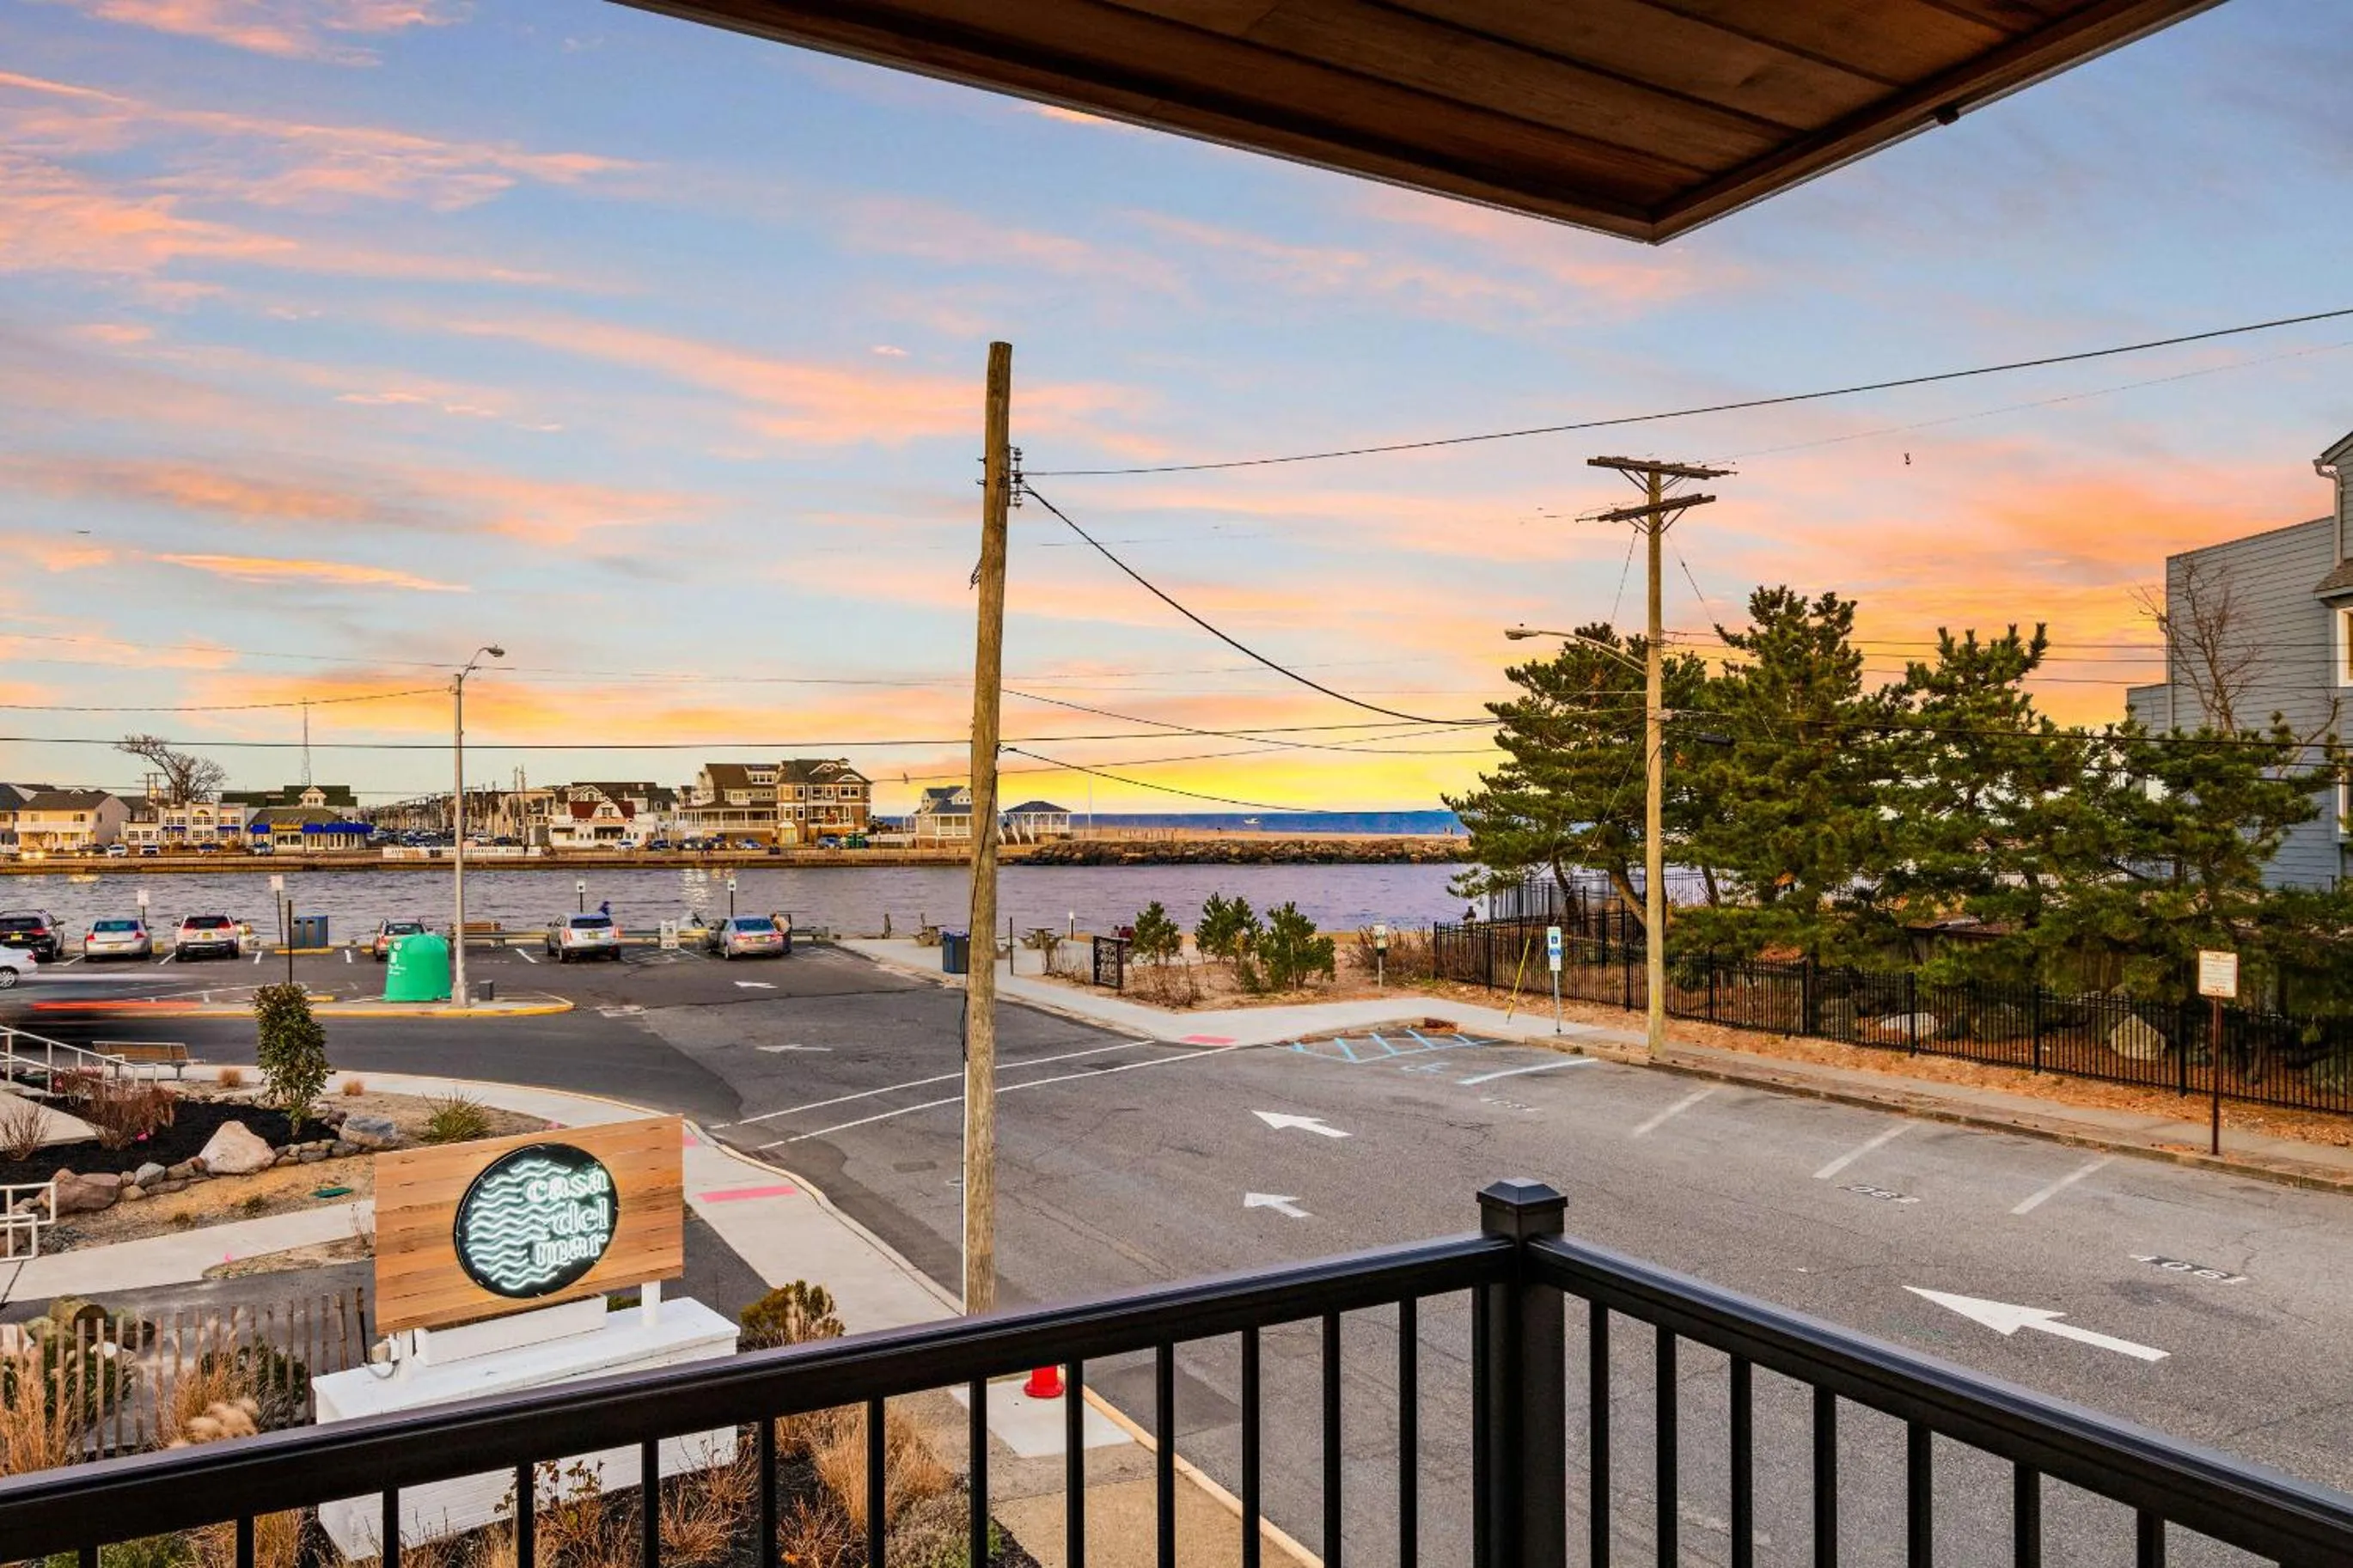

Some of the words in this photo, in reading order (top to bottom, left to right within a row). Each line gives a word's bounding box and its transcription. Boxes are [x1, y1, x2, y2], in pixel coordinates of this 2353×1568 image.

[526, 1169, 609, 1203] casa
[553, 1197, 608, 1235] del
[535, 1232, 608, 1266] mar
